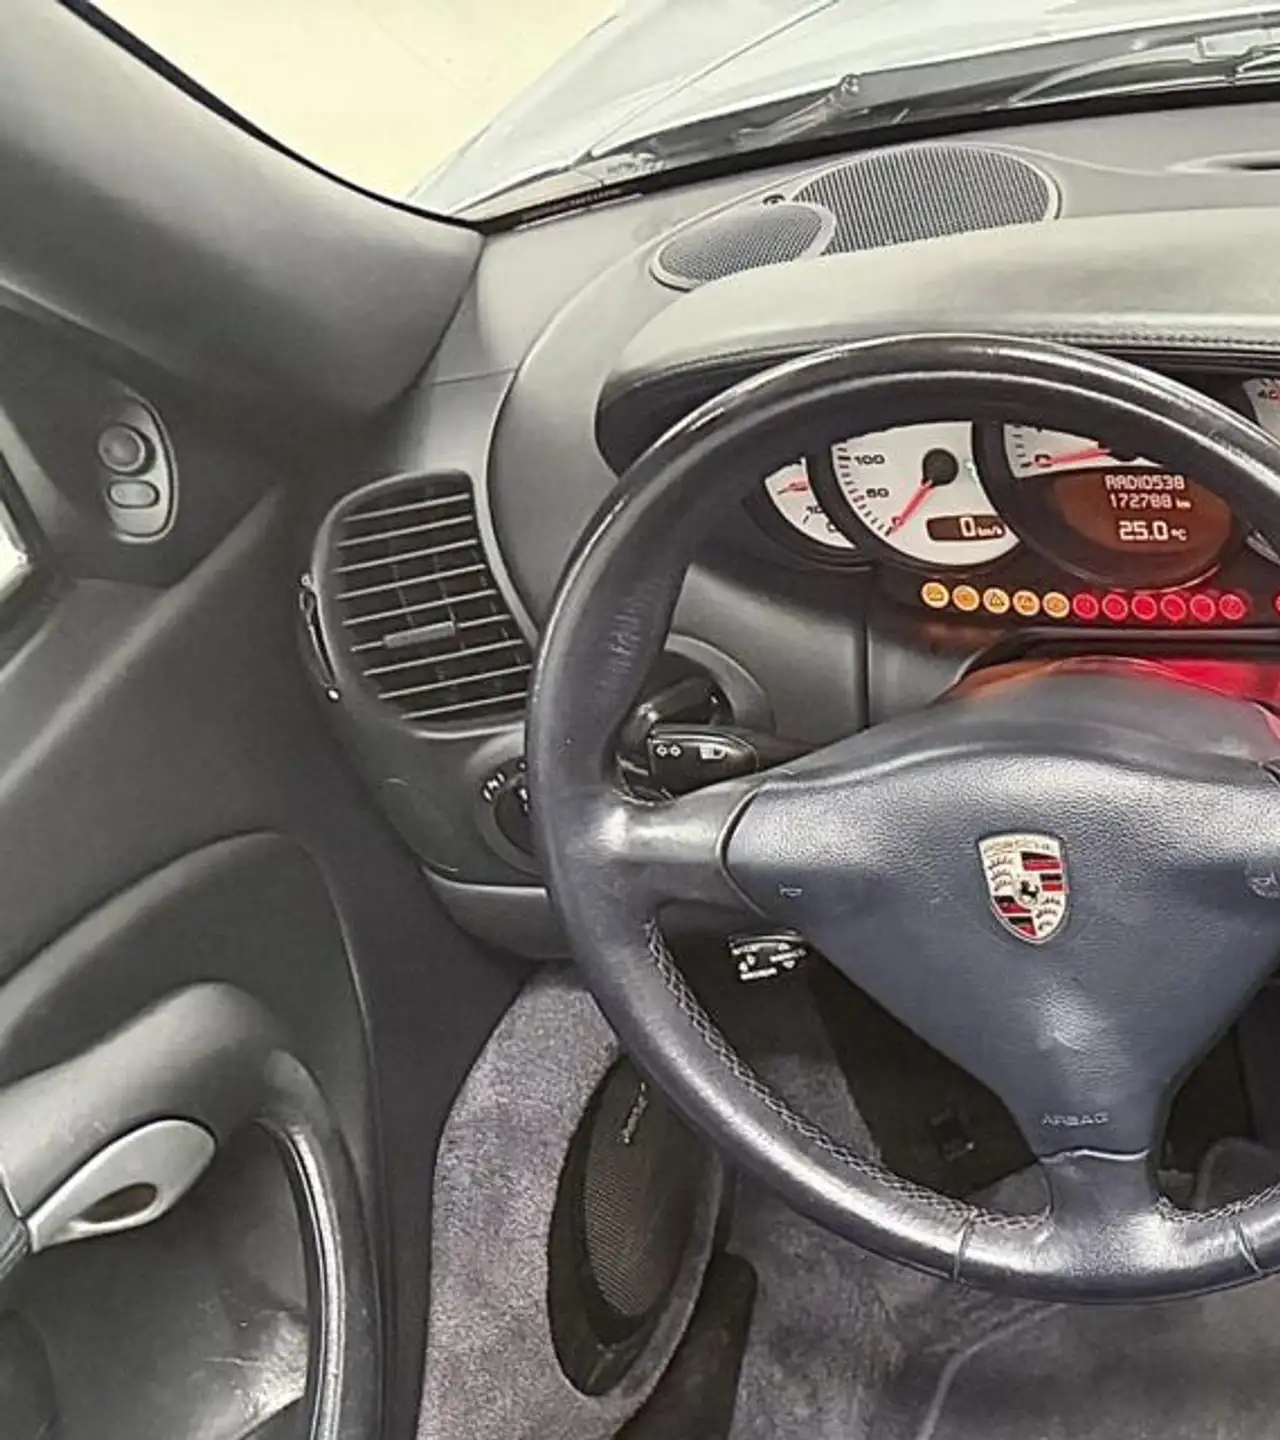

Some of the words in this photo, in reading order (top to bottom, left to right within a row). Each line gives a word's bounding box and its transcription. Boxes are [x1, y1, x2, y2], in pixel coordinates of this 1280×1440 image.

[854, 454, 886, 465] 100
[1104, 474, 1186, 491] RADIO538
[960, 516, 975, 537] 0
[1118, 520, 1169, 542] 25.0
